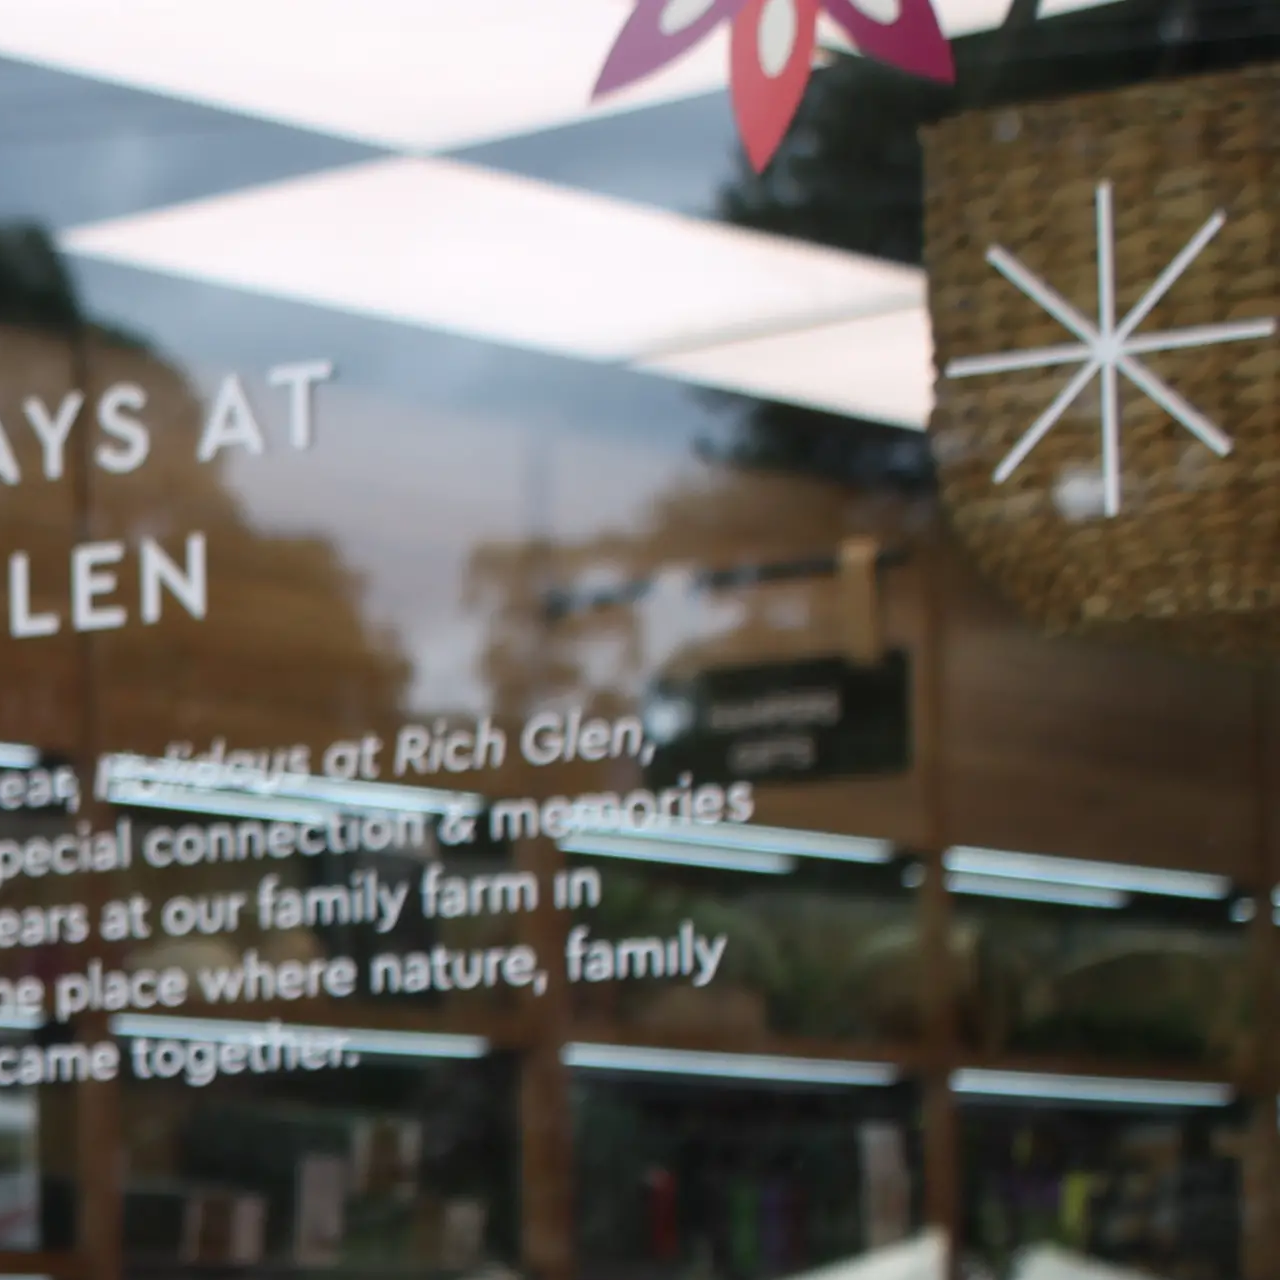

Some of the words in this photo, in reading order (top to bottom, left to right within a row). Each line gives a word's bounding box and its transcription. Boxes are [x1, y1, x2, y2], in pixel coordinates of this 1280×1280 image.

[197, 358, 333, 464] AT
[322, 731, 383, 780] at
[393, 717, 507, 776] Rich
[520, 707, 656, 767] Glen,
[143, 798, 427, 868] connection
[439, 797, 476, 846] &
[490, 772, 756, 842] memories
[98, 895, 151, 941] at
[162, 890, 246, 935] our
[256, 868, 410, 934] family
[420, 863, 539, 919] farm
[554, 865, 601, 910] in
[54, 958, 188, 1019] place
[197, 948, 357, 1002] where
[370, 942, 549, 994] nature,
[565, 918, 729, 988] family
[130, 1016, 361, 1087] together.
